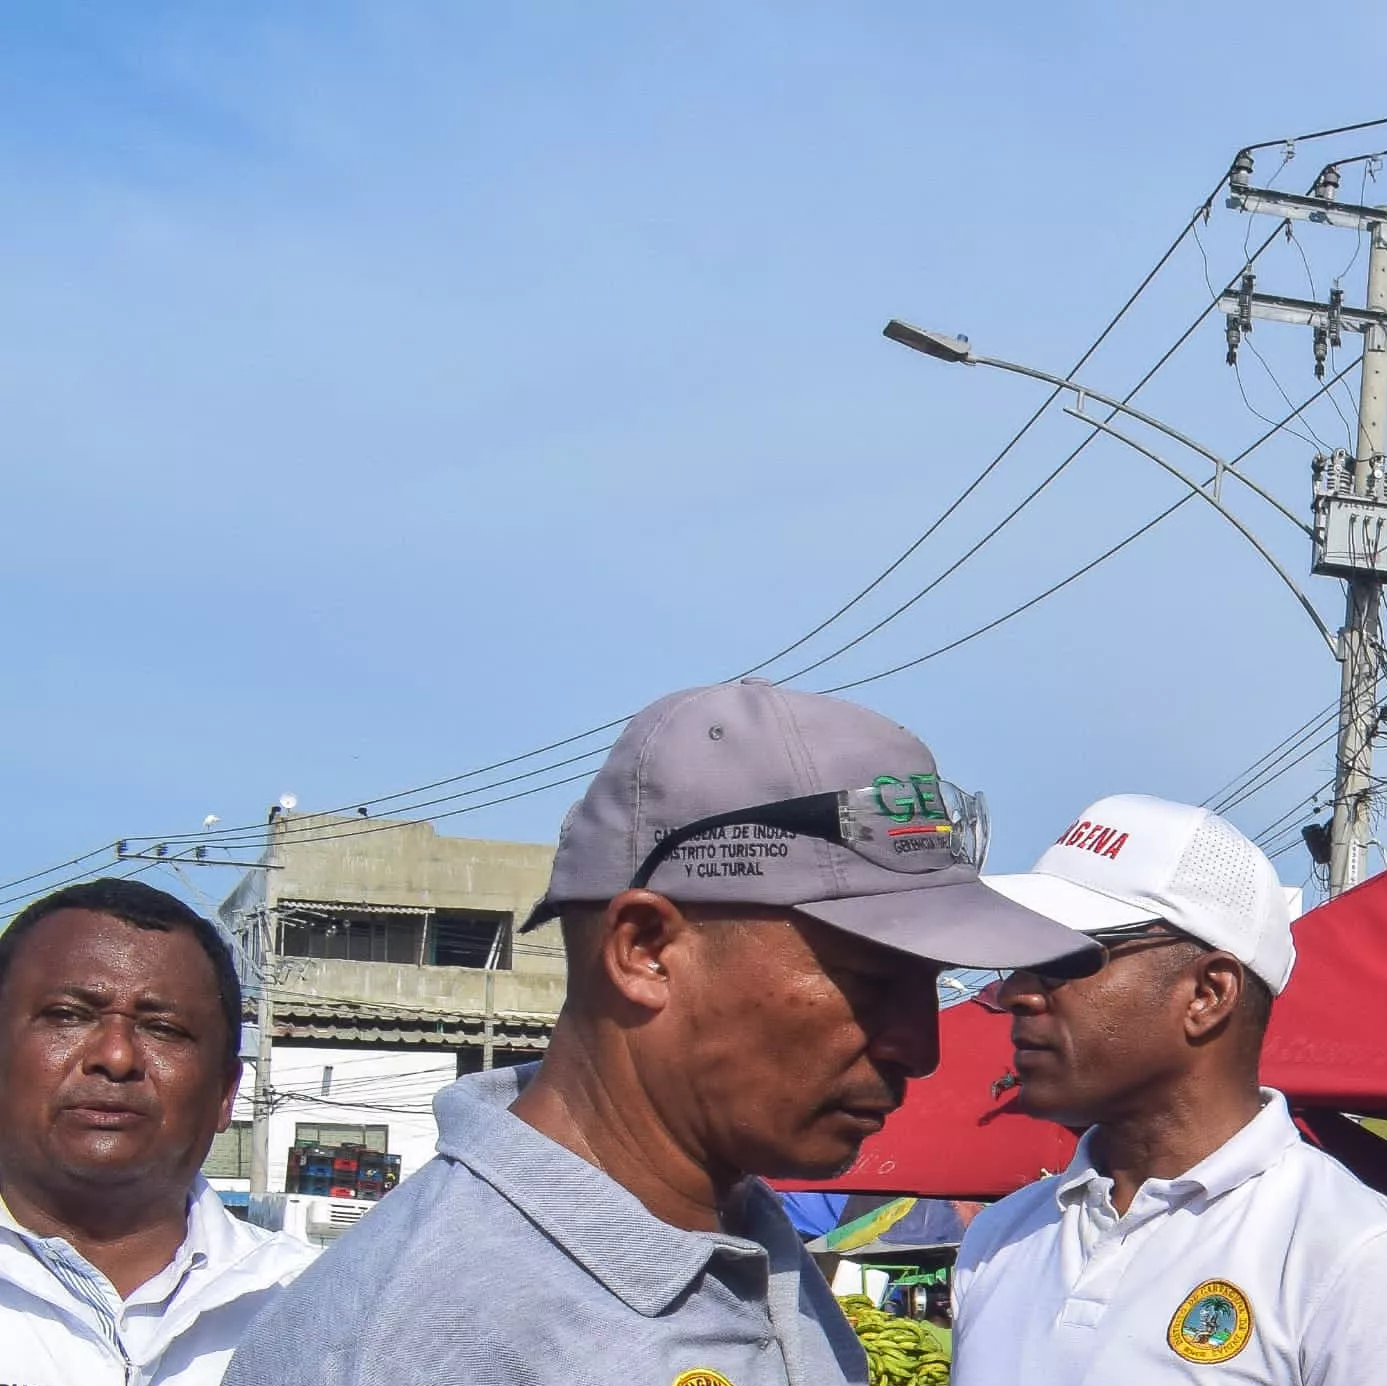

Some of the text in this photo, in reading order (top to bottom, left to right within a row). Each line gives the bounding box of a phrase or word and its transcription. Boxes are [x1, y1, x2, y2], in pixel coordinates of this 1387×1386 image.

[732, 826, 749, 840] DE
[685, 862, 764, 877] Y CULTURAL
